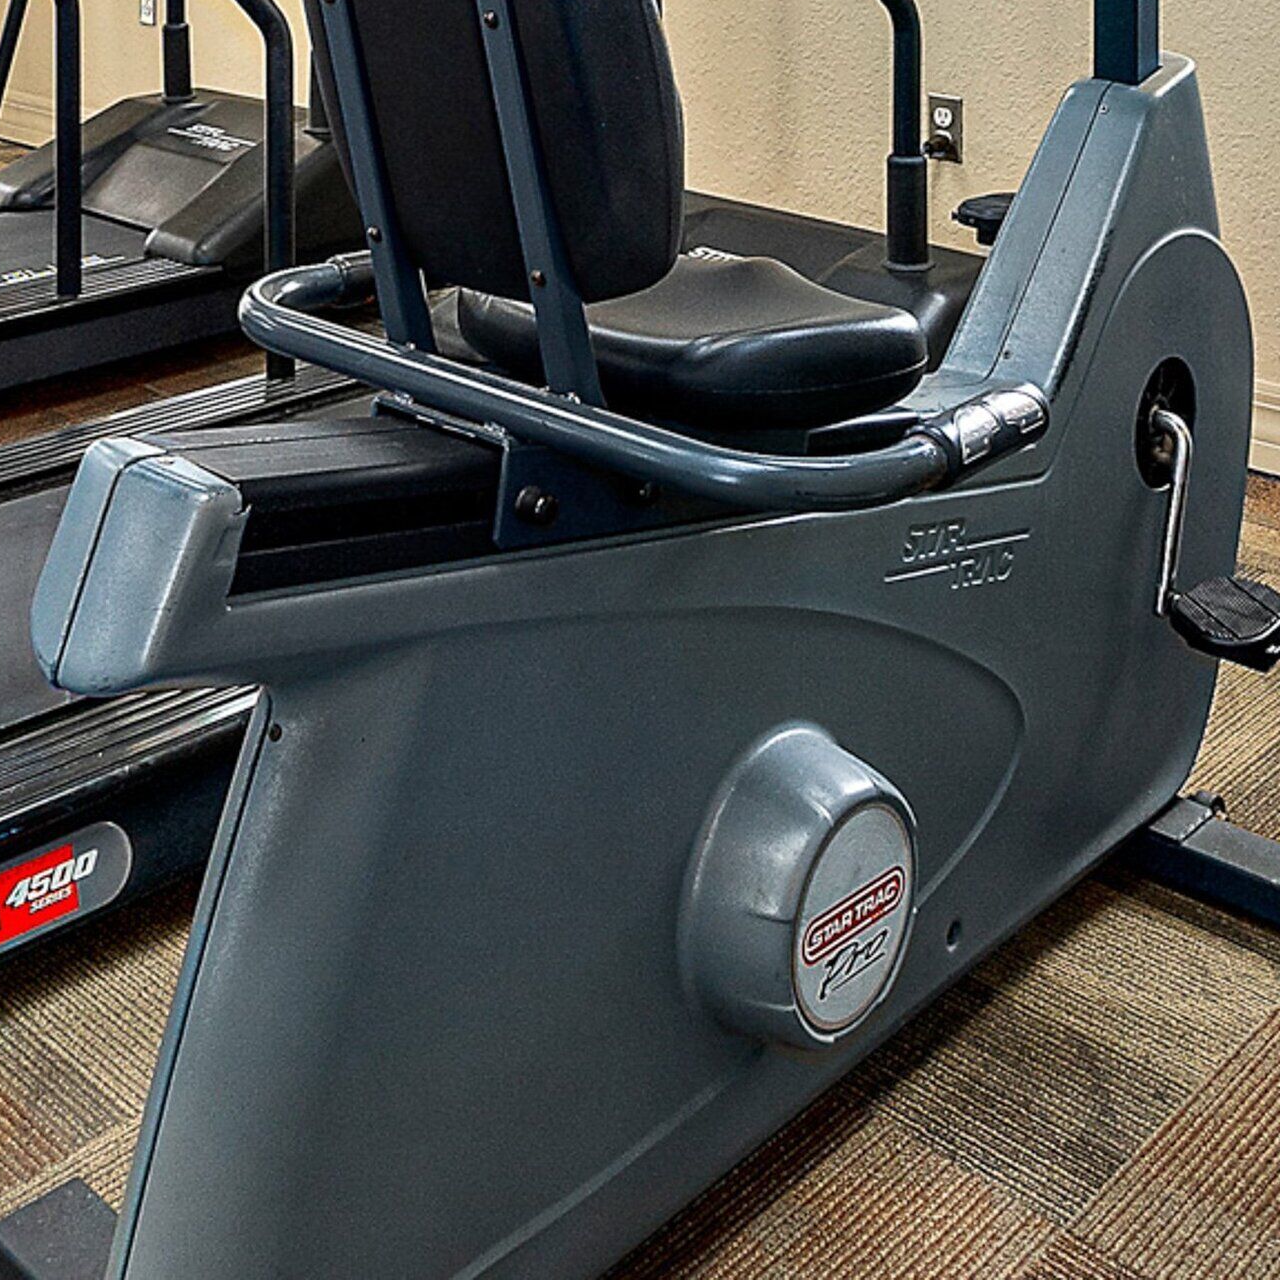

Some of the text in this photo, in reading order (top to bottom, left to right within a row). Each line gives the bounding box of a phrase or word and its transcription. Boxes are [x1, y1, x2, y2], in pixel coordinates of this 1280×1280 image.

[902, 518, 965, 563] STAR
[950, 547, 1014, 589] TRAC
[5, 848, 98, 908] 4500
[29, 886, 73, 914] SERIES
[811, 881, 898, 947] STAR TRAC
